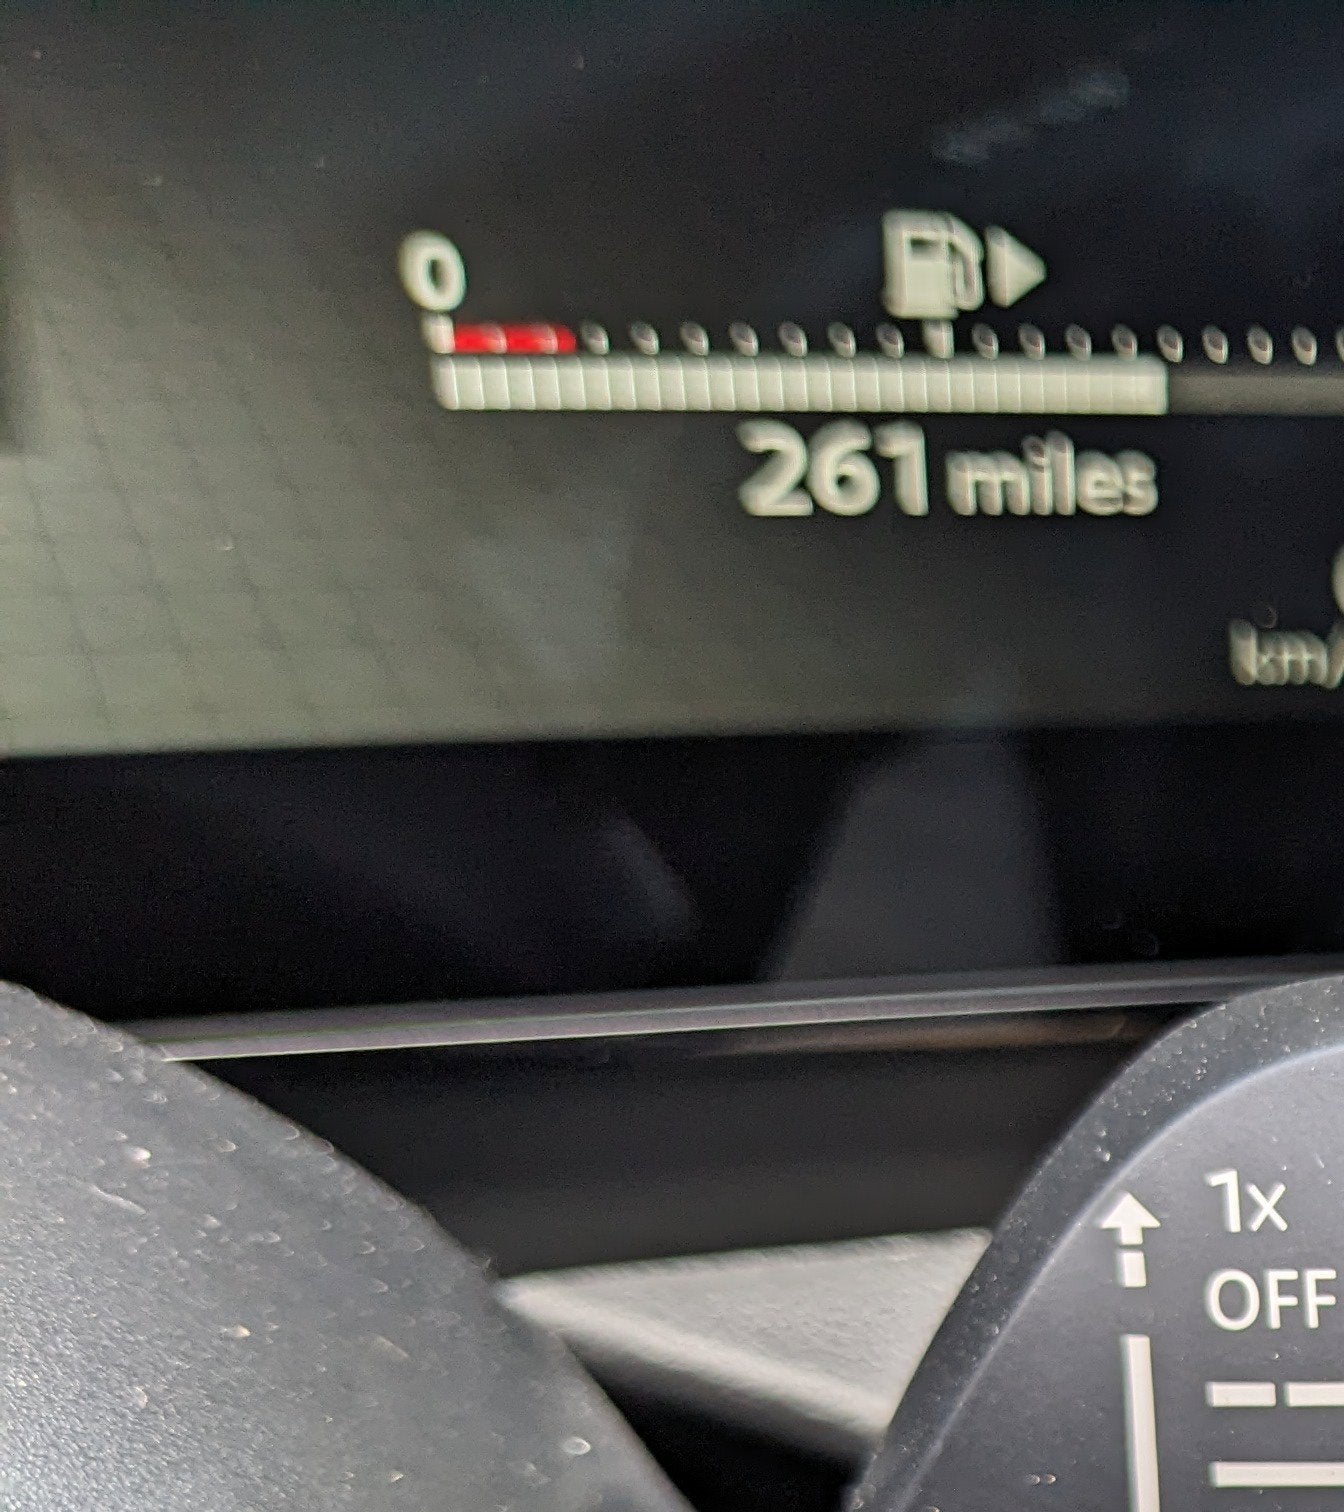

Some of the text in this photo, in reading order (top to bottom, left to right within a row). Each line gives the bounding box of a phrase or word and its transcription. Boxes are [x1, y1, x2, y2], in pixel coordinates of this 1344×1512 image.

[400, 231, 466, 311] 0
[738, 420, 1159, 517] 261 miles
[1204, 1167, 1289, 1234] 1x
[1205, 1268, 1337, 1332] OFF
